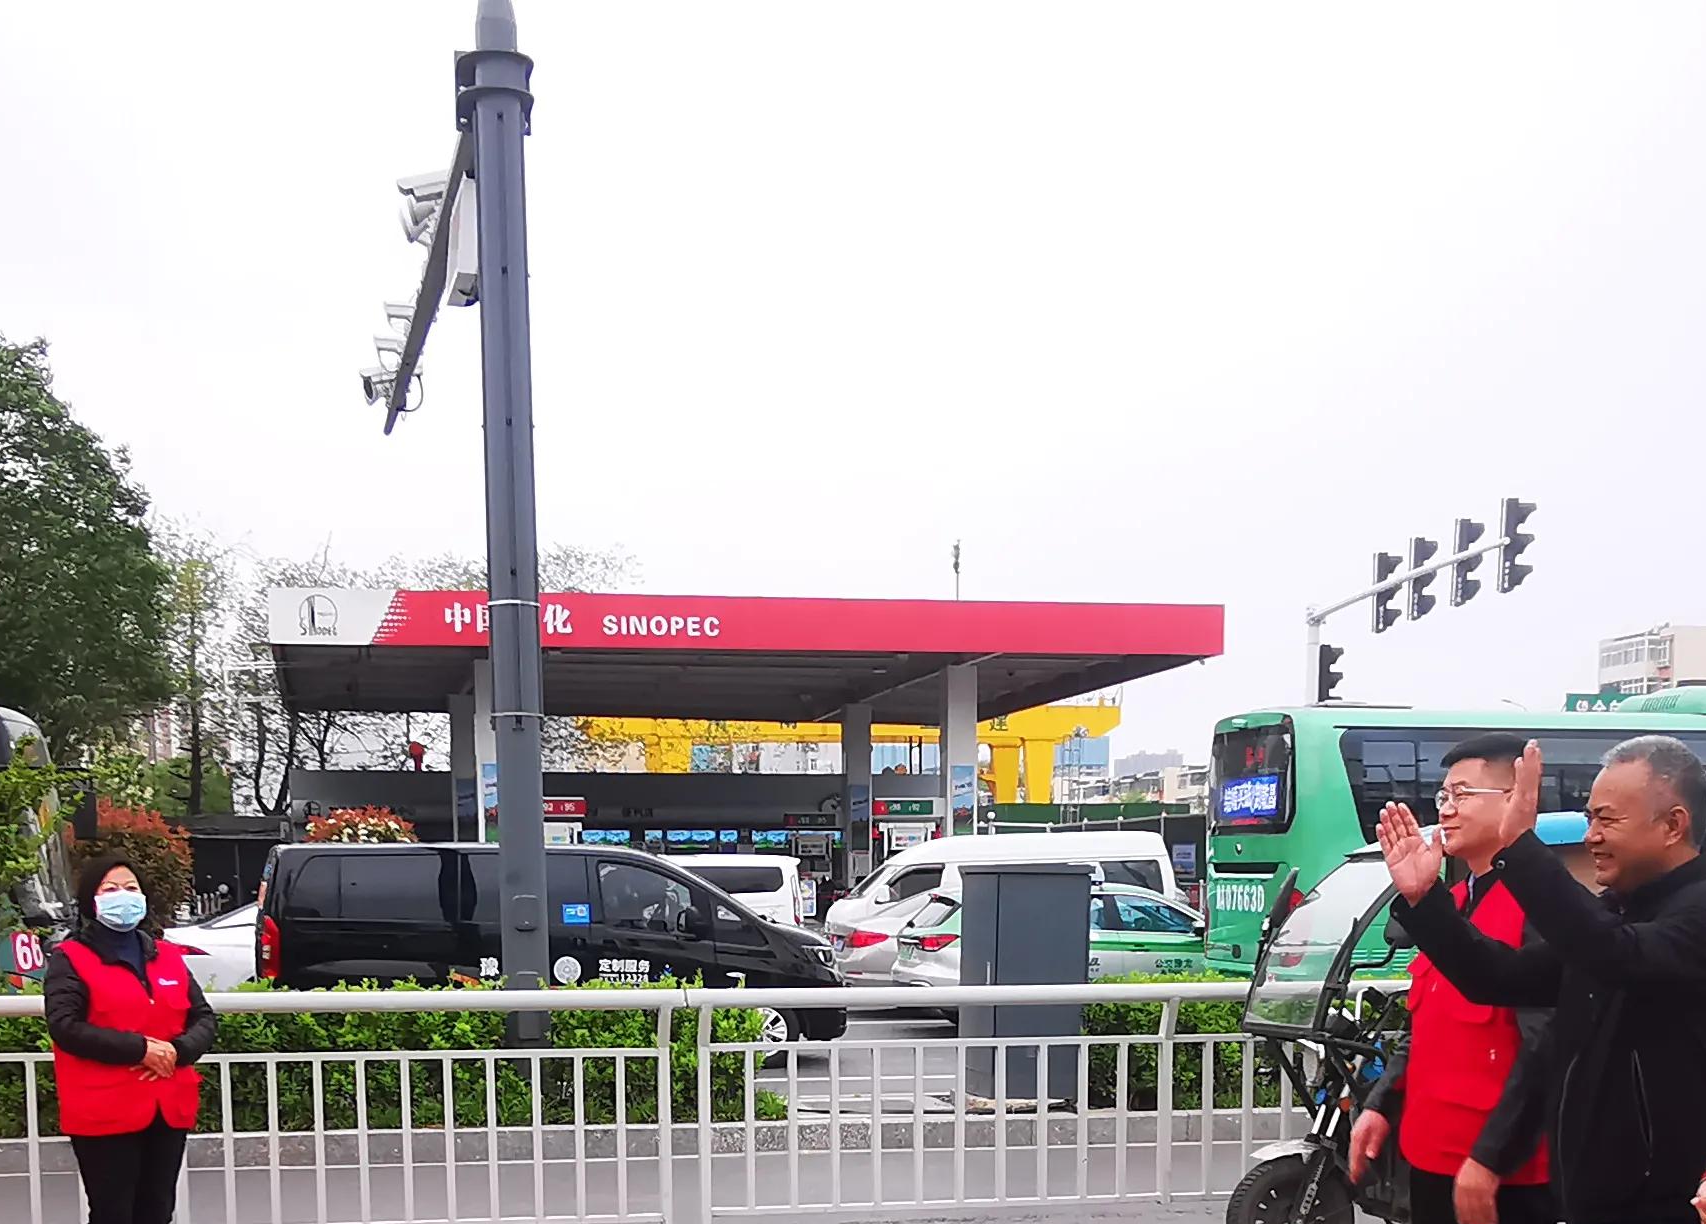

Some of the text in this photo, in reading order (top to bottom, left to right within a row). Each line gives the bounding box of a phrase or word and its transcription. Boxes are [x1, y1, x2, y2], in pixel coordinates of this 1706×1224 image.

[444, 602, 574, 634] 中化
[602, 614, 721, 638] SINOPEC
[16, 933, 44, 970] 66
[598, 958, 651, 973] 定制服务
